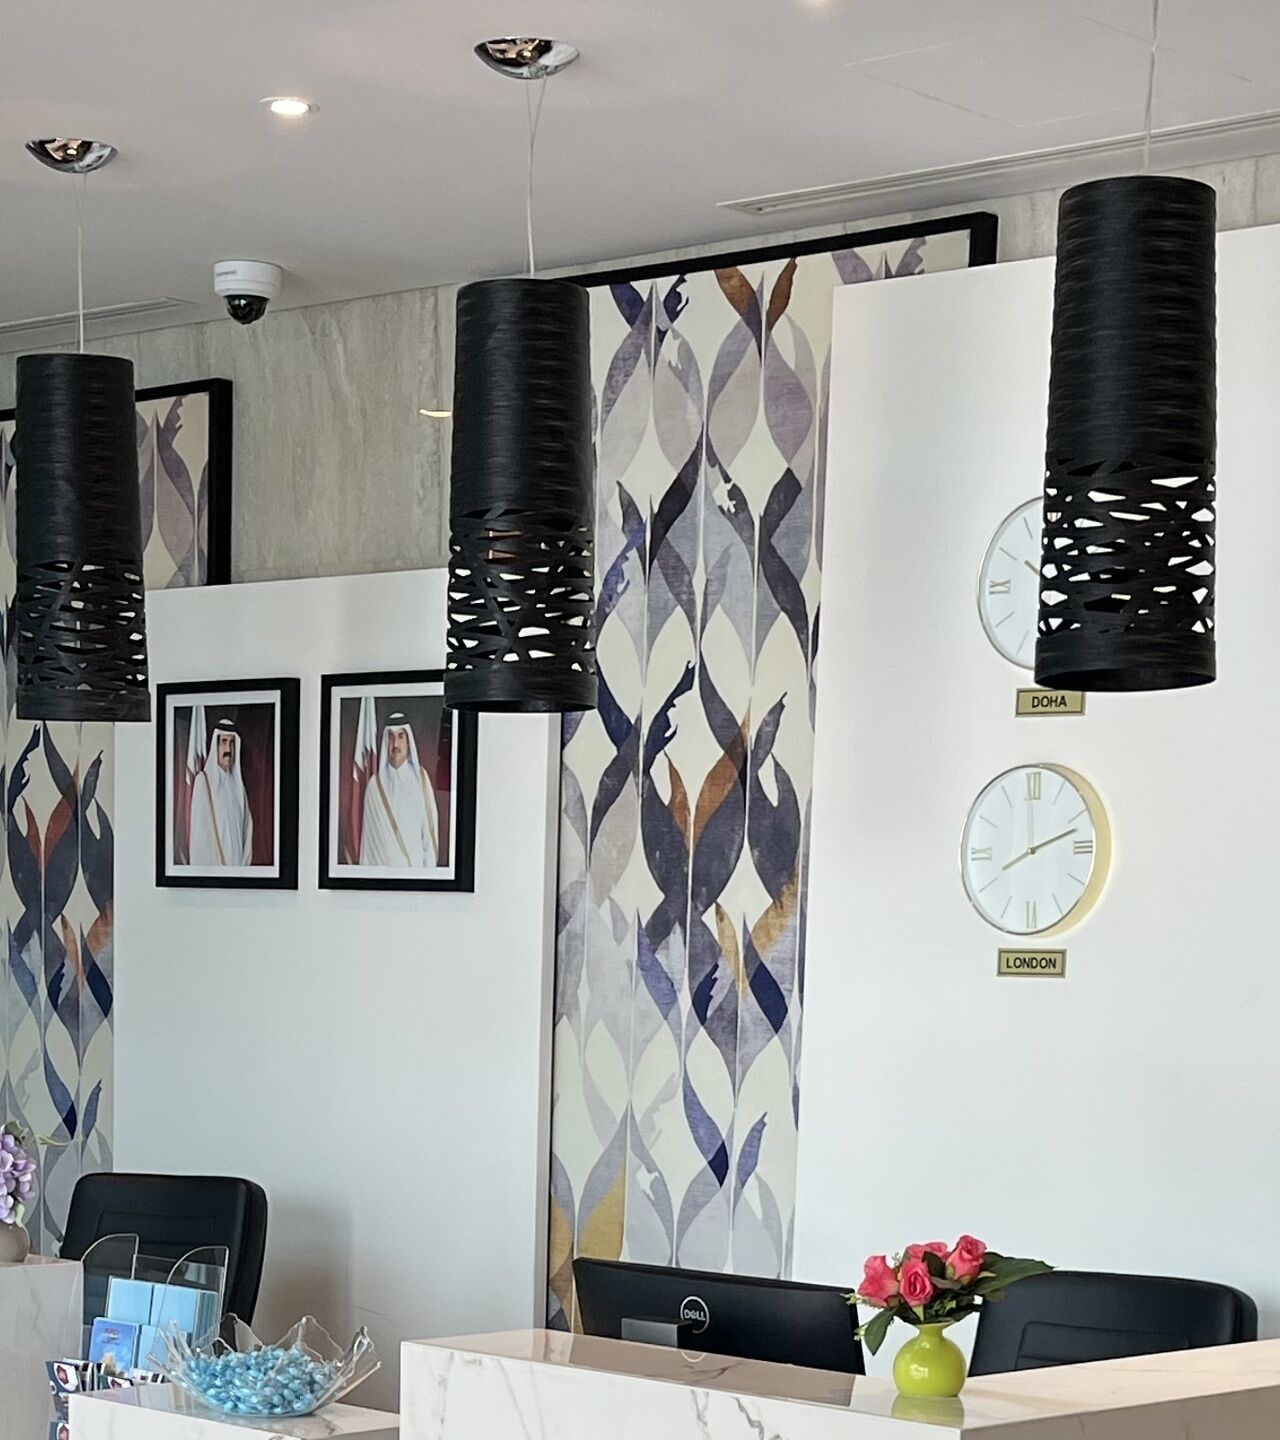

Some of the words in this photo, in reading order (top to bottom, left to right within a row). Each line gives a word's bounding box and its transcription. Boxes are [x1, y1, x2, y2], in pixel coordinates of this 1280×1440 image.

[1032, 695, 1067, 708] DOHA
[1006, 956, 1057, 970] LONDON
[683, 1308, 706, 1321] DELL
